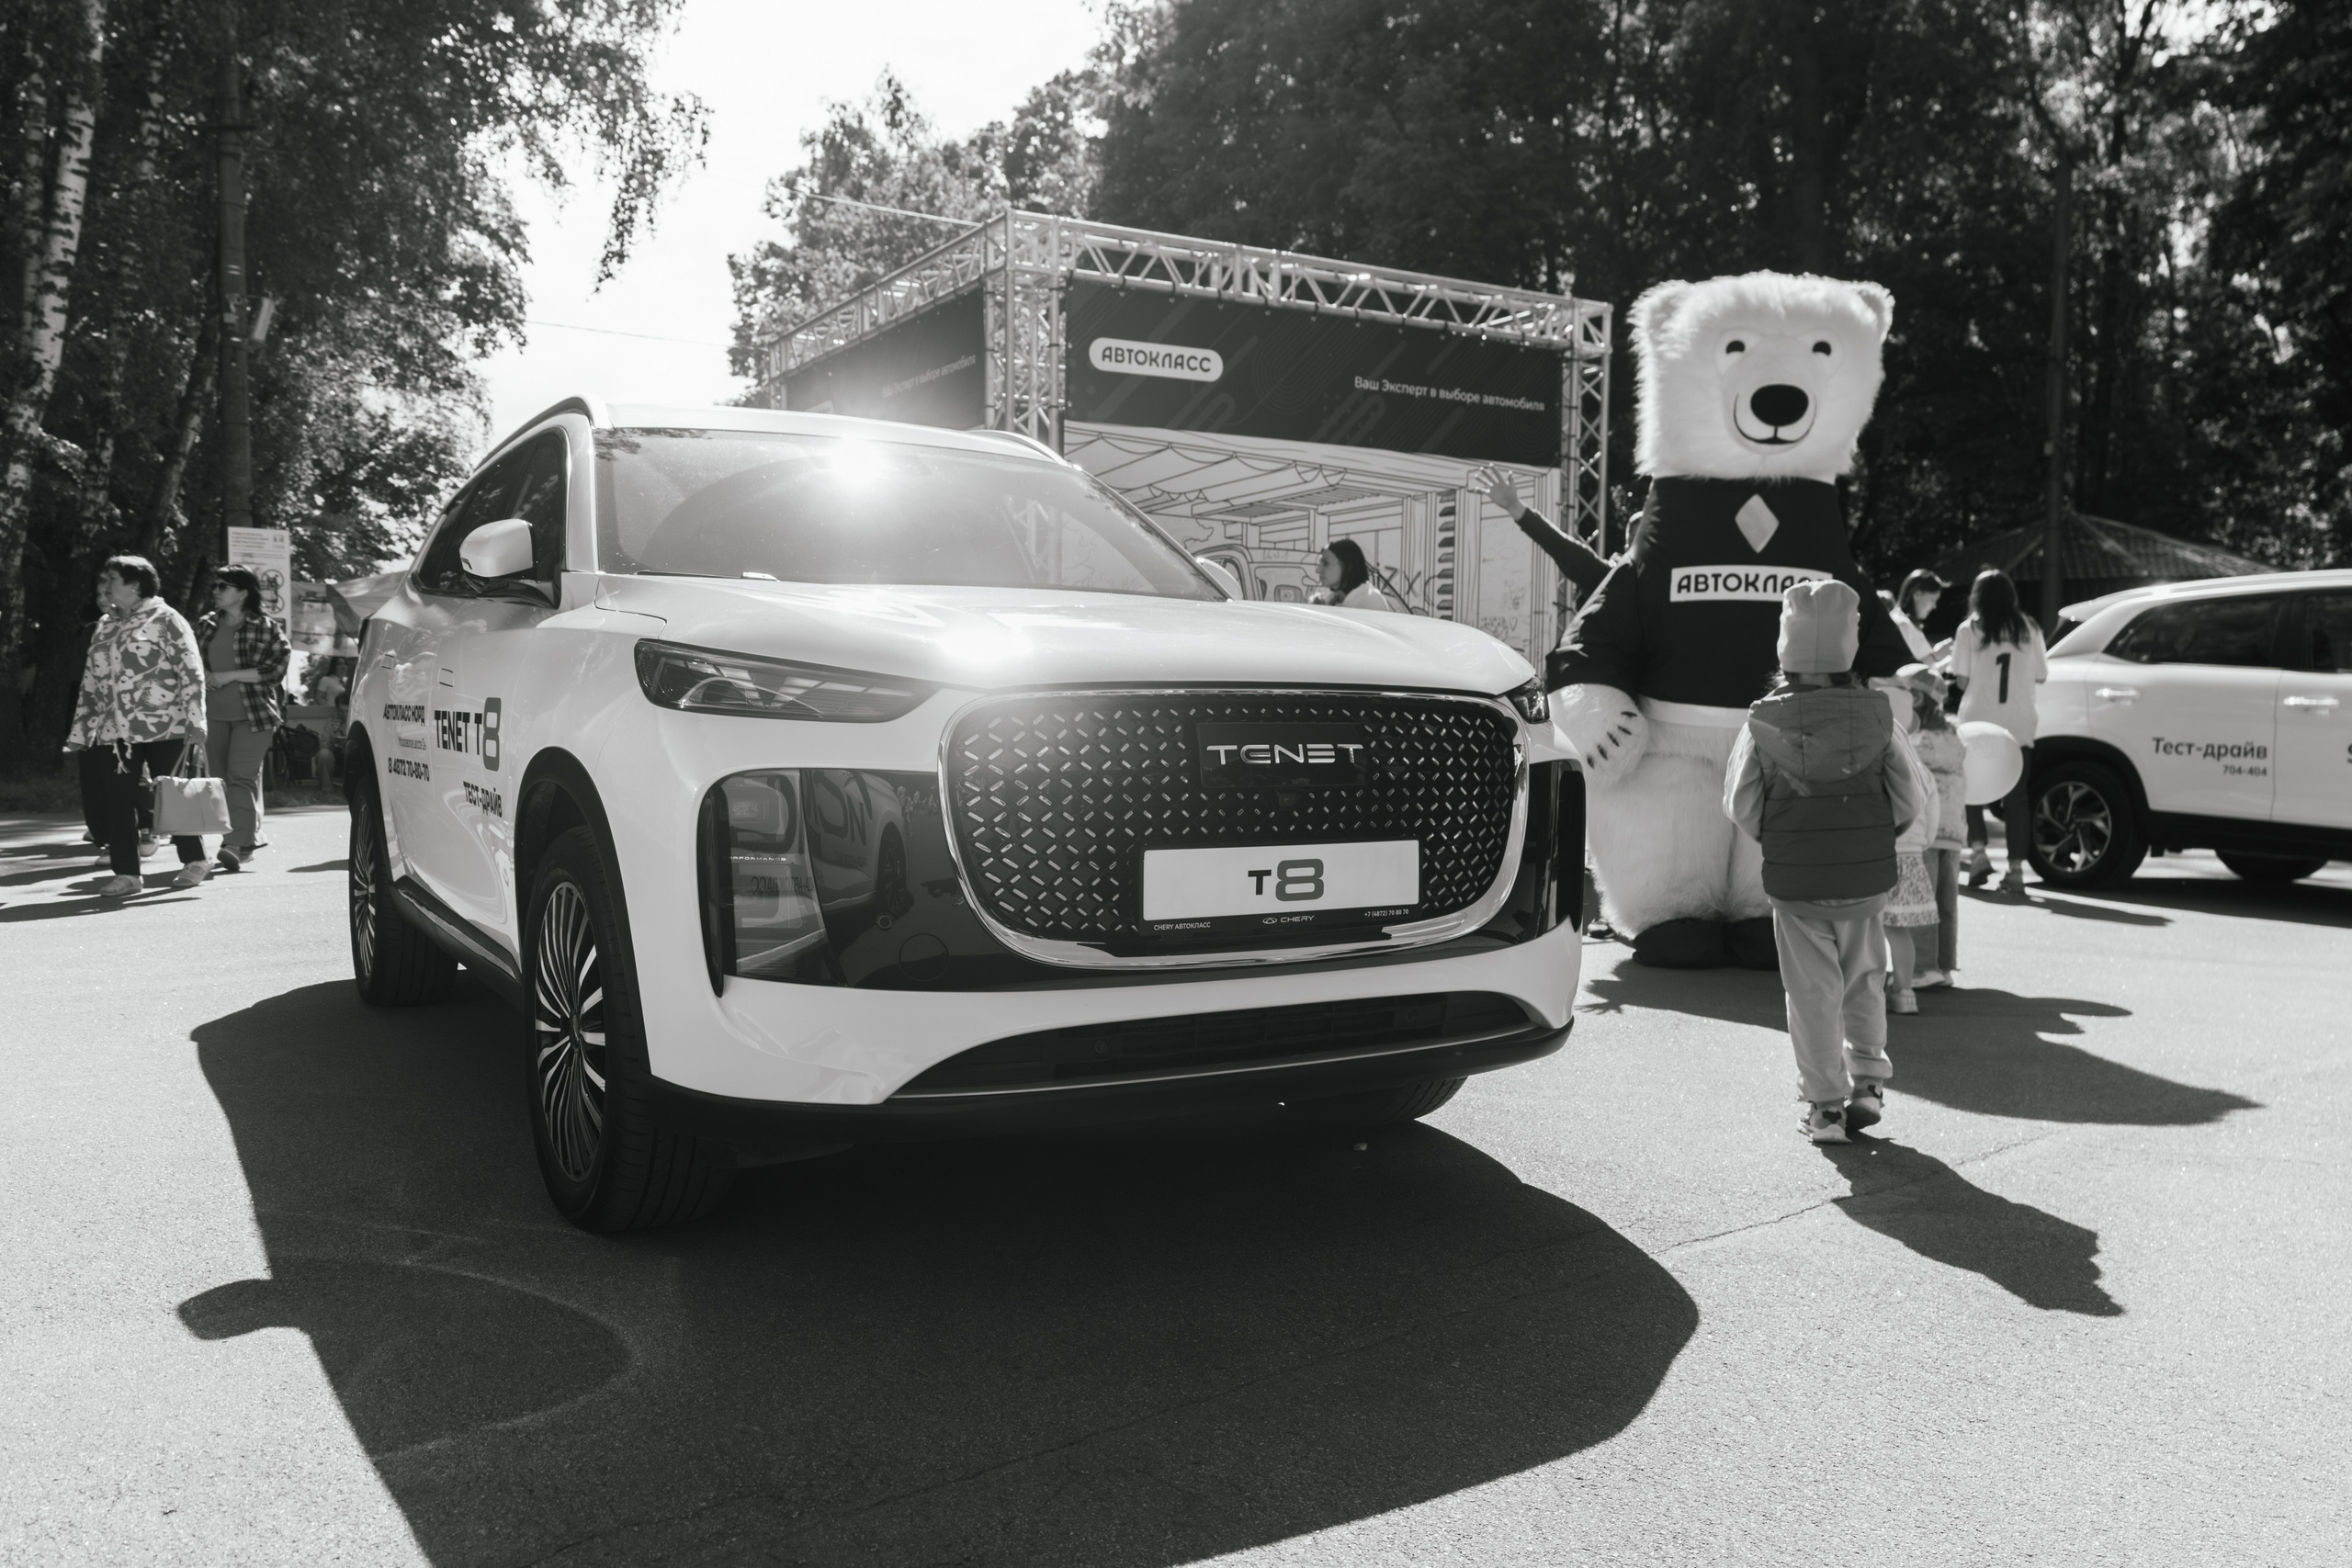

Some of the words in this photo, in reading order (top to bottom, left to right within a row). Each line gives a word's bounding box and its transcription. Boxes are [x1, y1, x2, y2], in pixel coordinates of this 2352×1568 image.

[1102, 346, 1211, 373] АВТОКЛАСС
[1354, 376, 1379, 390] Ваш
[1382, 379, 1428, 398] Эксперт
[1430, 388, 1437, 398] в
[1439, 389, 1480, 404] выборе
[1482, 395, 1545, 412] автомобиля
[1678, 573, 1825, 594] АВТОКЛА
[1996, 653, 2011, 705] 1
[435, 710, 470, 753] TENET
[474, 697, 502, 772] T8
[1206, 744, 1363, 765] TENET
[2153, 737, 2267, 761] Тест-драйв
[389, 757, 392, 773] 8
[2222, 764, 2267, 777] 704-404
[463, 781, 503, 818] ТЕСТ-ДРАЙВ
[1248, 858, 1324, 902] T8
[1175, 921, 1211, 930] АВТОКЛАСС
[1281, 915, 1314, 923] CHERY
